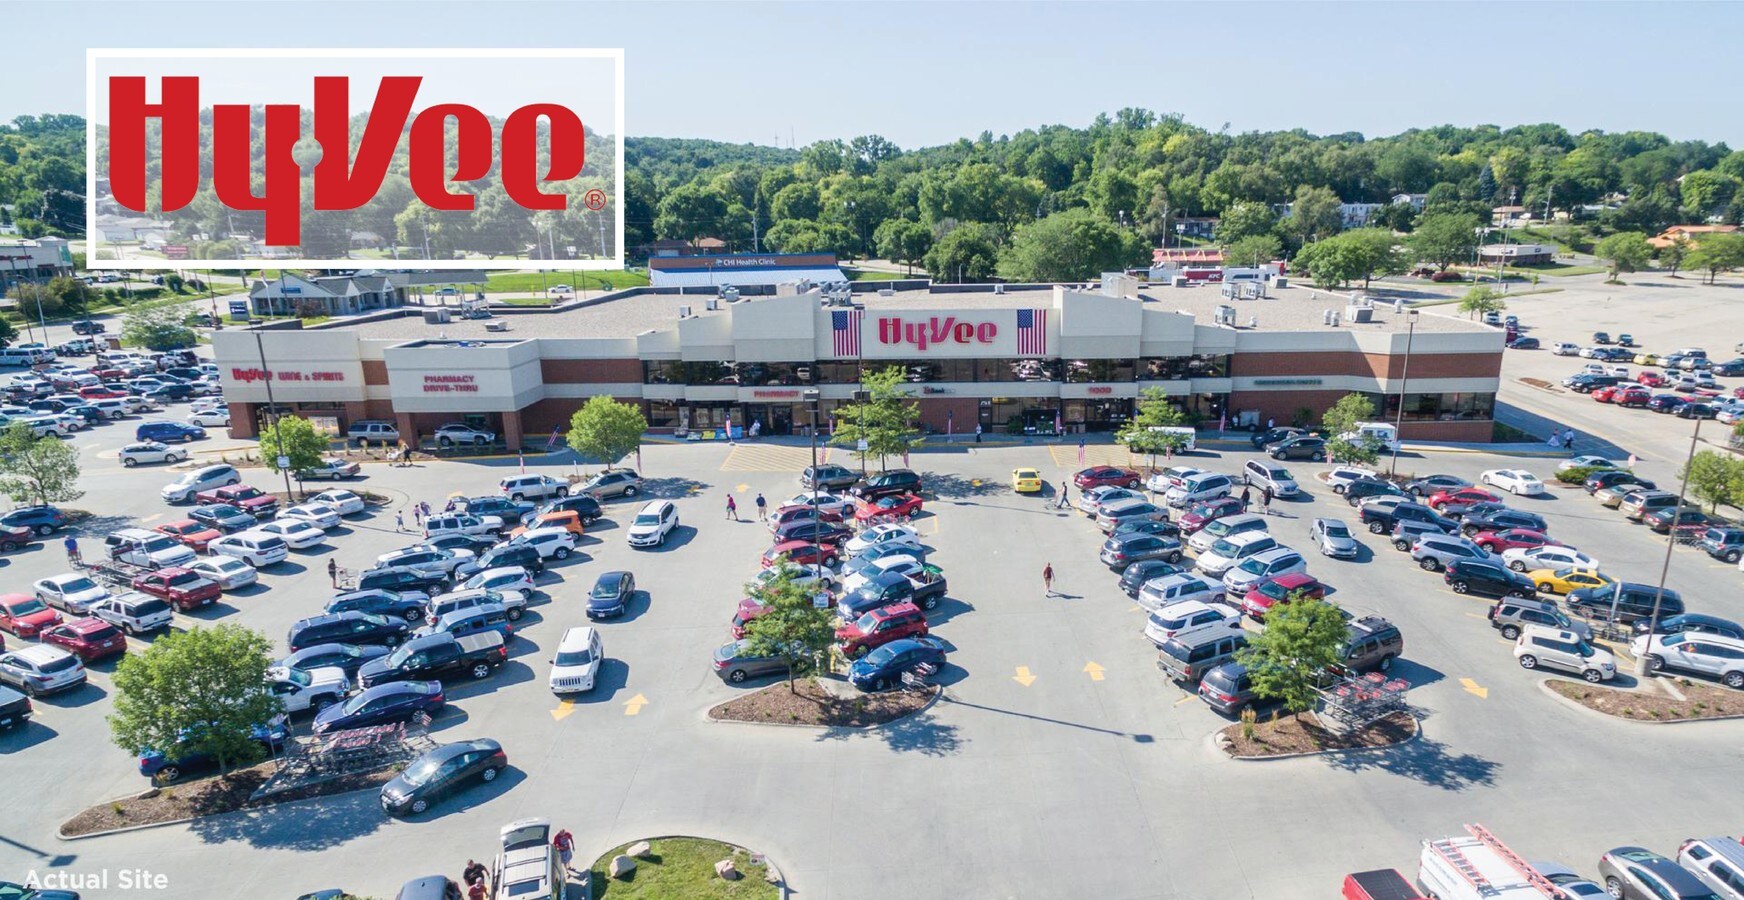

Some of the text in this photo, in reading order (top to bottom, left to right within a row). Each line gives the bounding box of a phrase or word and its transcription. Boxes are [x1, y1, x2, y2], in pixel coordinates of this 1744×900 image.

[278, 372, 302, 381] WINE
[311, 372, 344, 381] SPIRITS
[424, 375, 475, 383] PHARMACY
[423, 384, 479, 392] DRIVE-THRU
